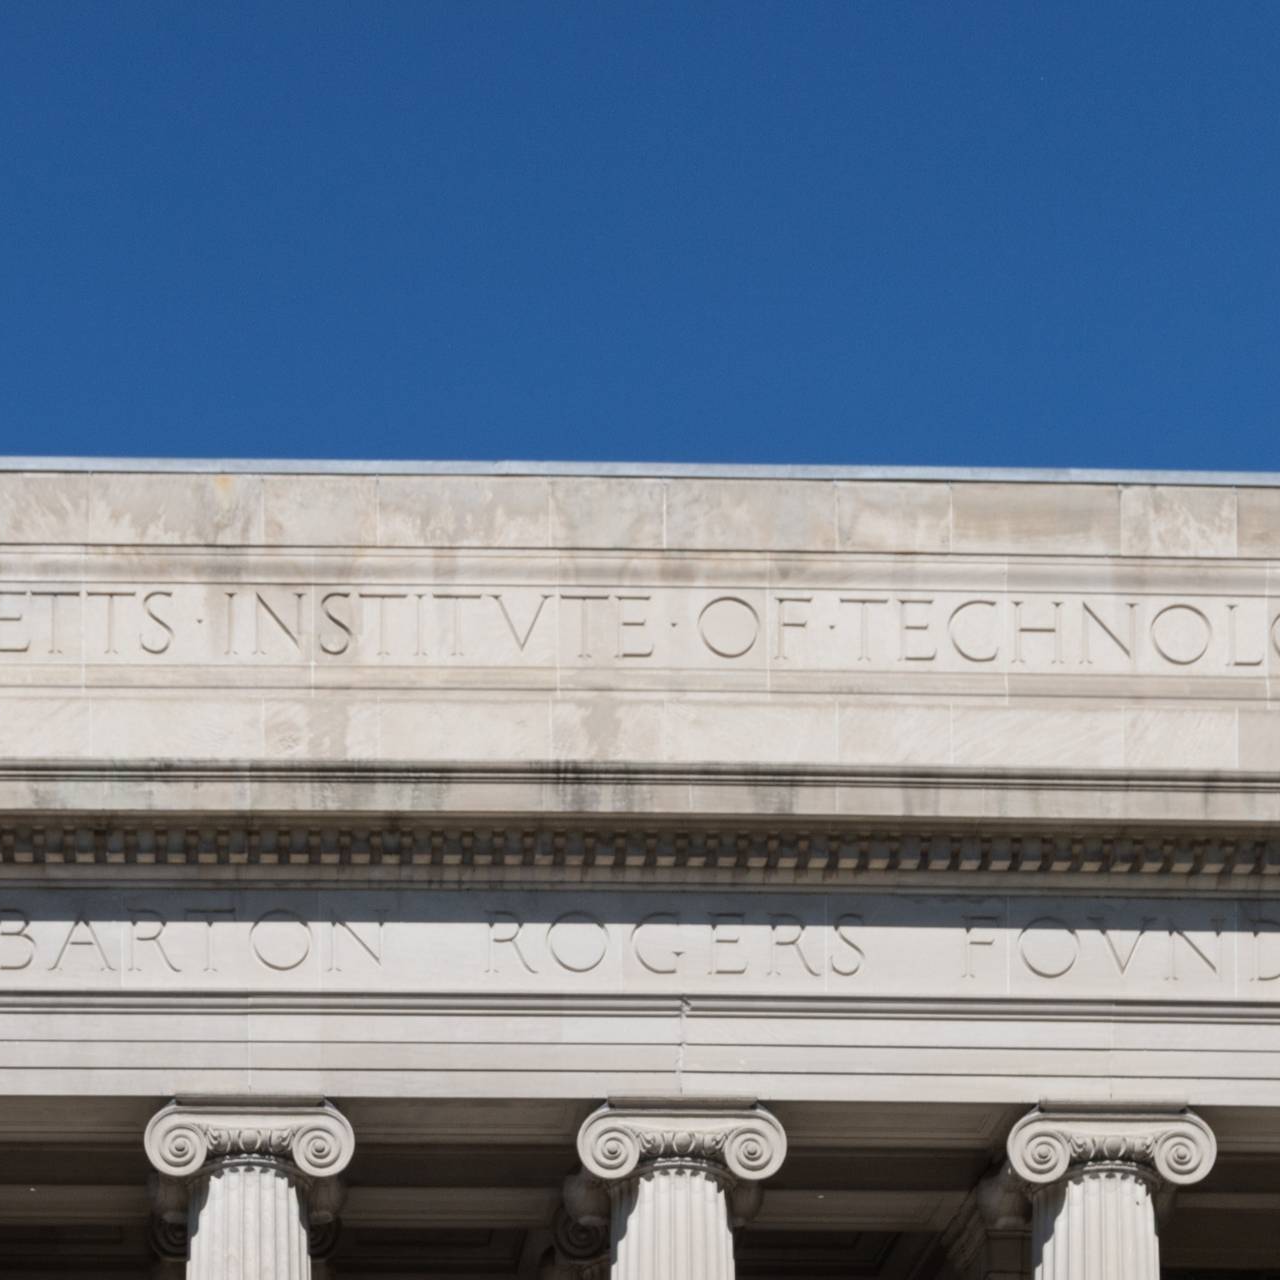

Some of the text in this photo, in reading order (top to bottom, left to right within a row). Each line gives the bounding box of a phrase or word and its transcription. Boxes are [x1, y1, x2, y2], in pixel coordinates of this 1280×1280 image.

[223, 591, 654, 659] INSTITVTE
[698, 596, 813, 661] OF
[485, 910, 865, 977] ROGERS
